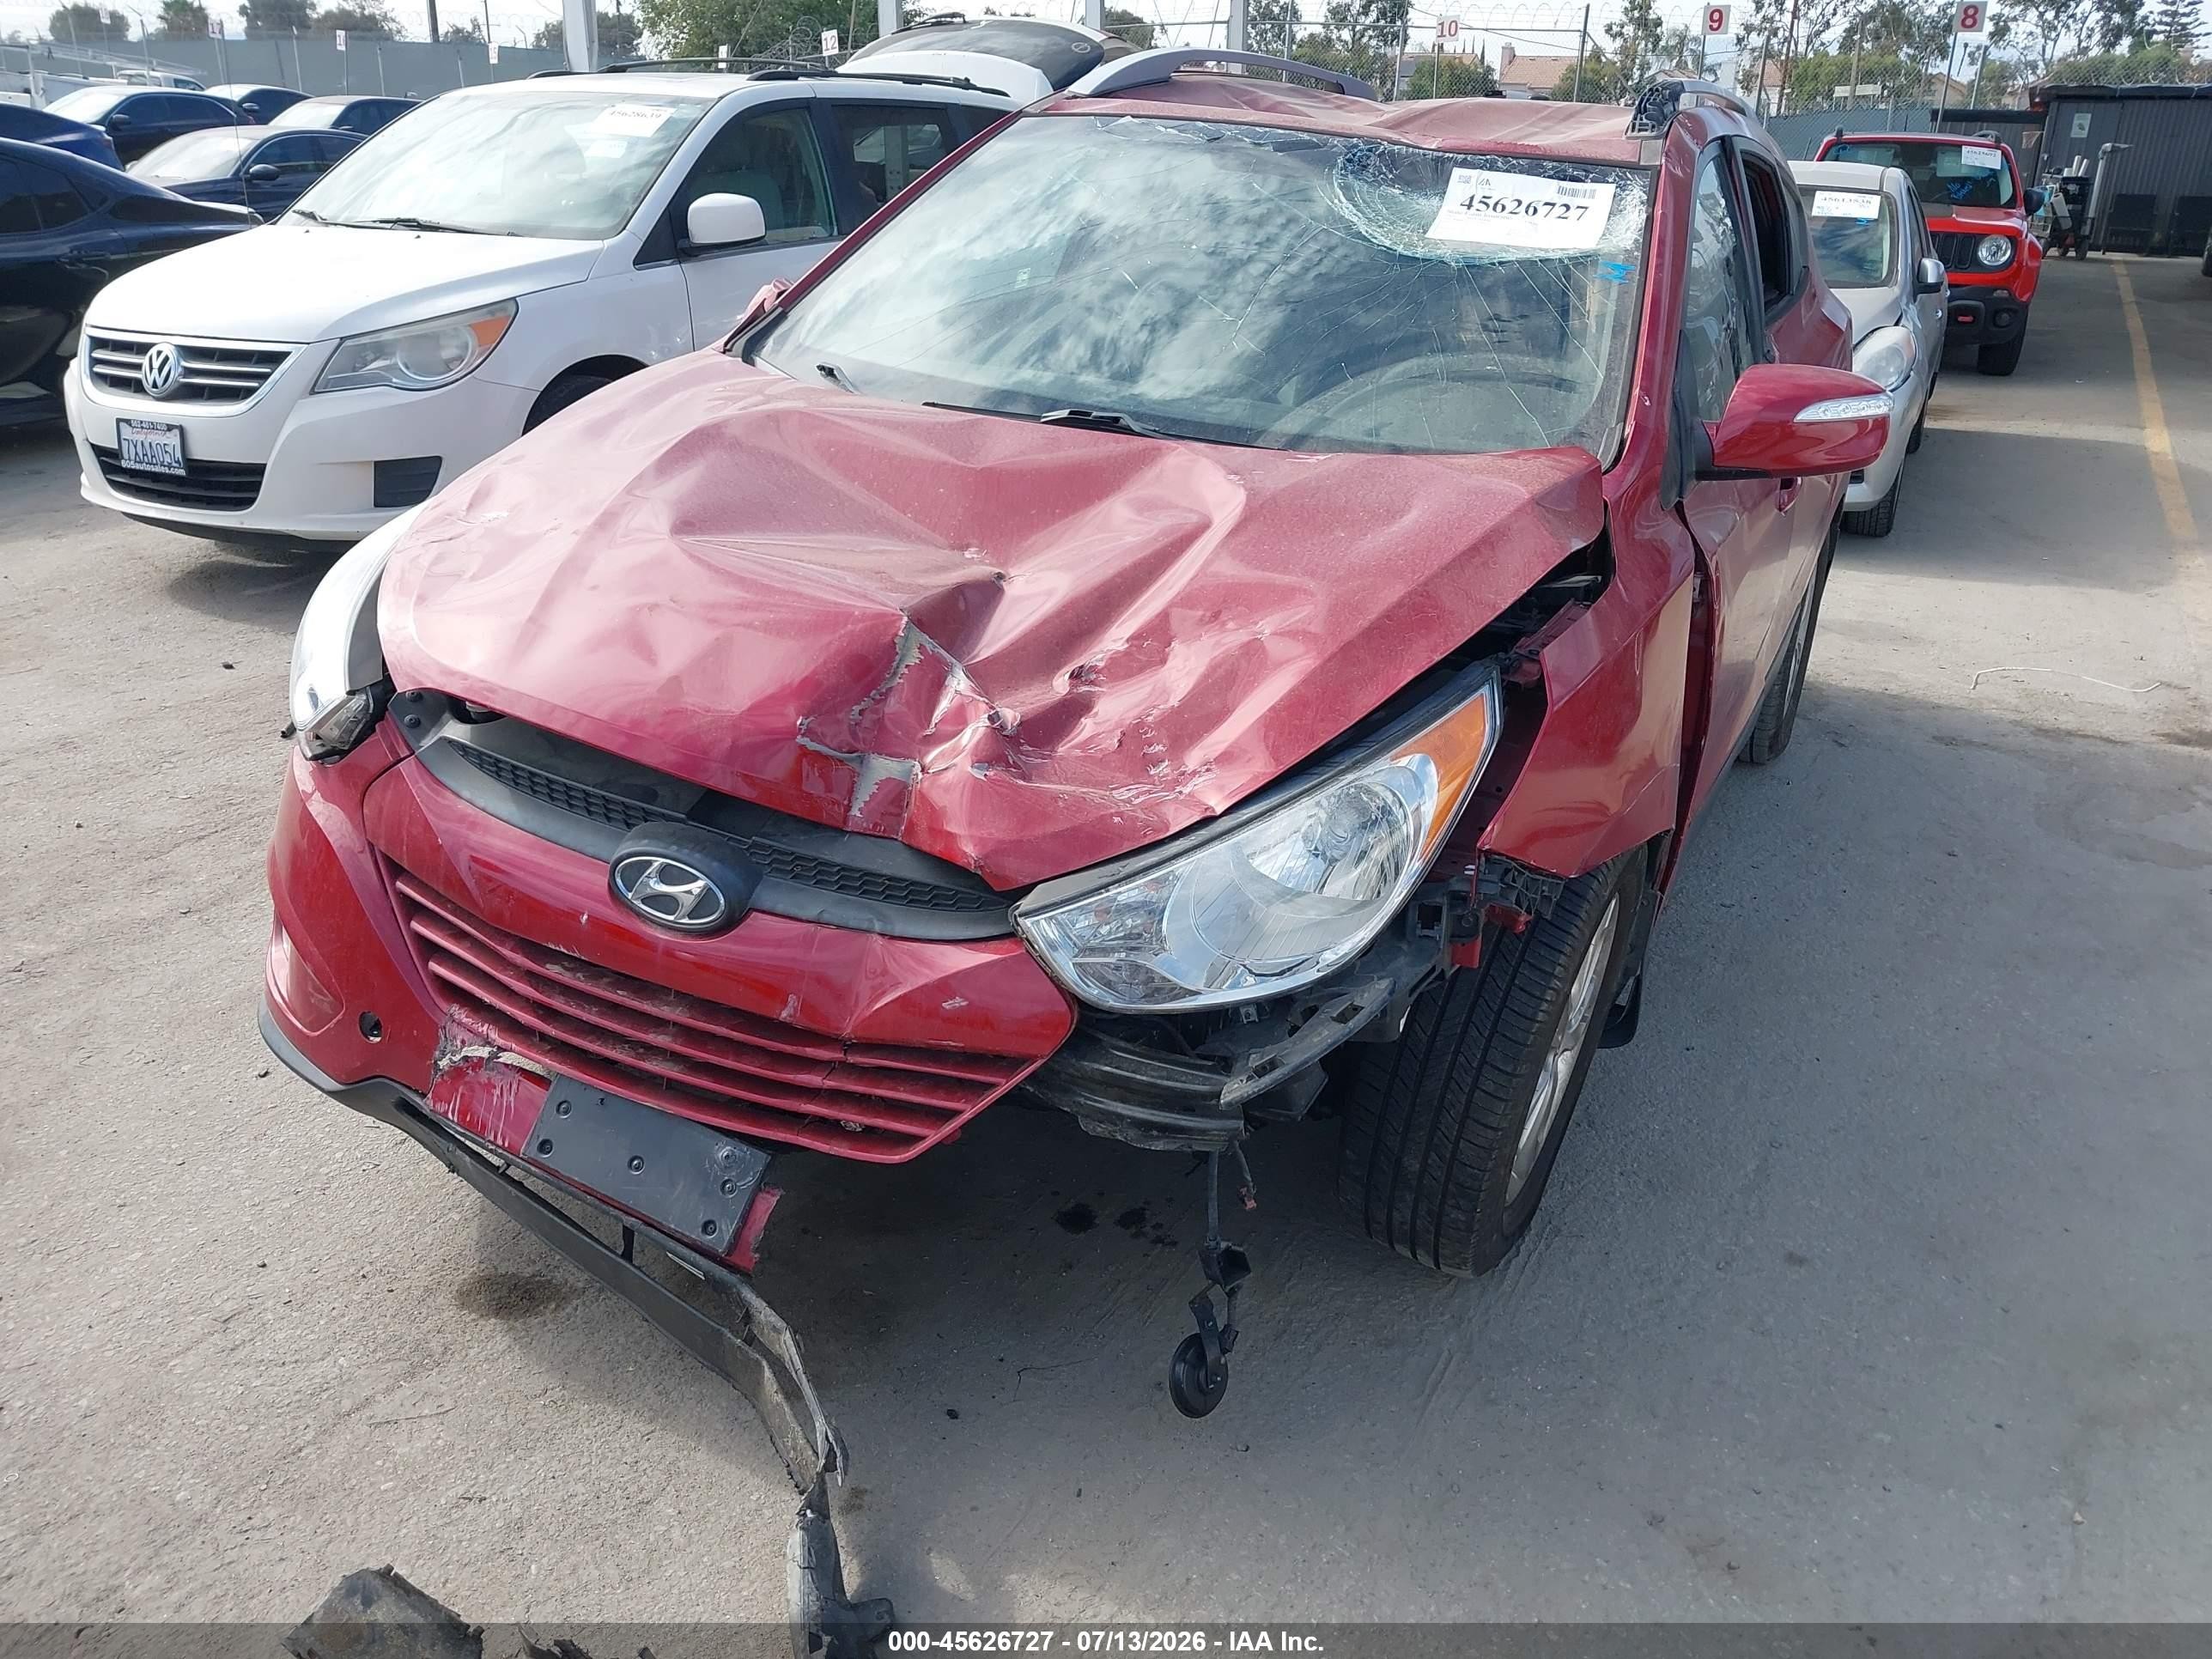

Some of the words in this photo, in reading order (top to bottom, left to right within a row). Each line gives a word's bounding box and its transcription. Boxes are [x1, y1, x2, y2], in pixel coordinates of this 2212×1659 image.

[1709, 9, 1724, 31] 9
[1961, 4, 1978, 29] 8
[1437, 20, 1459, 38] 10
[823, 35, 837, 52] 12
[1460, 194, 1589, 222] 45626727
[122, 437, 183, 468] 7XAA054
